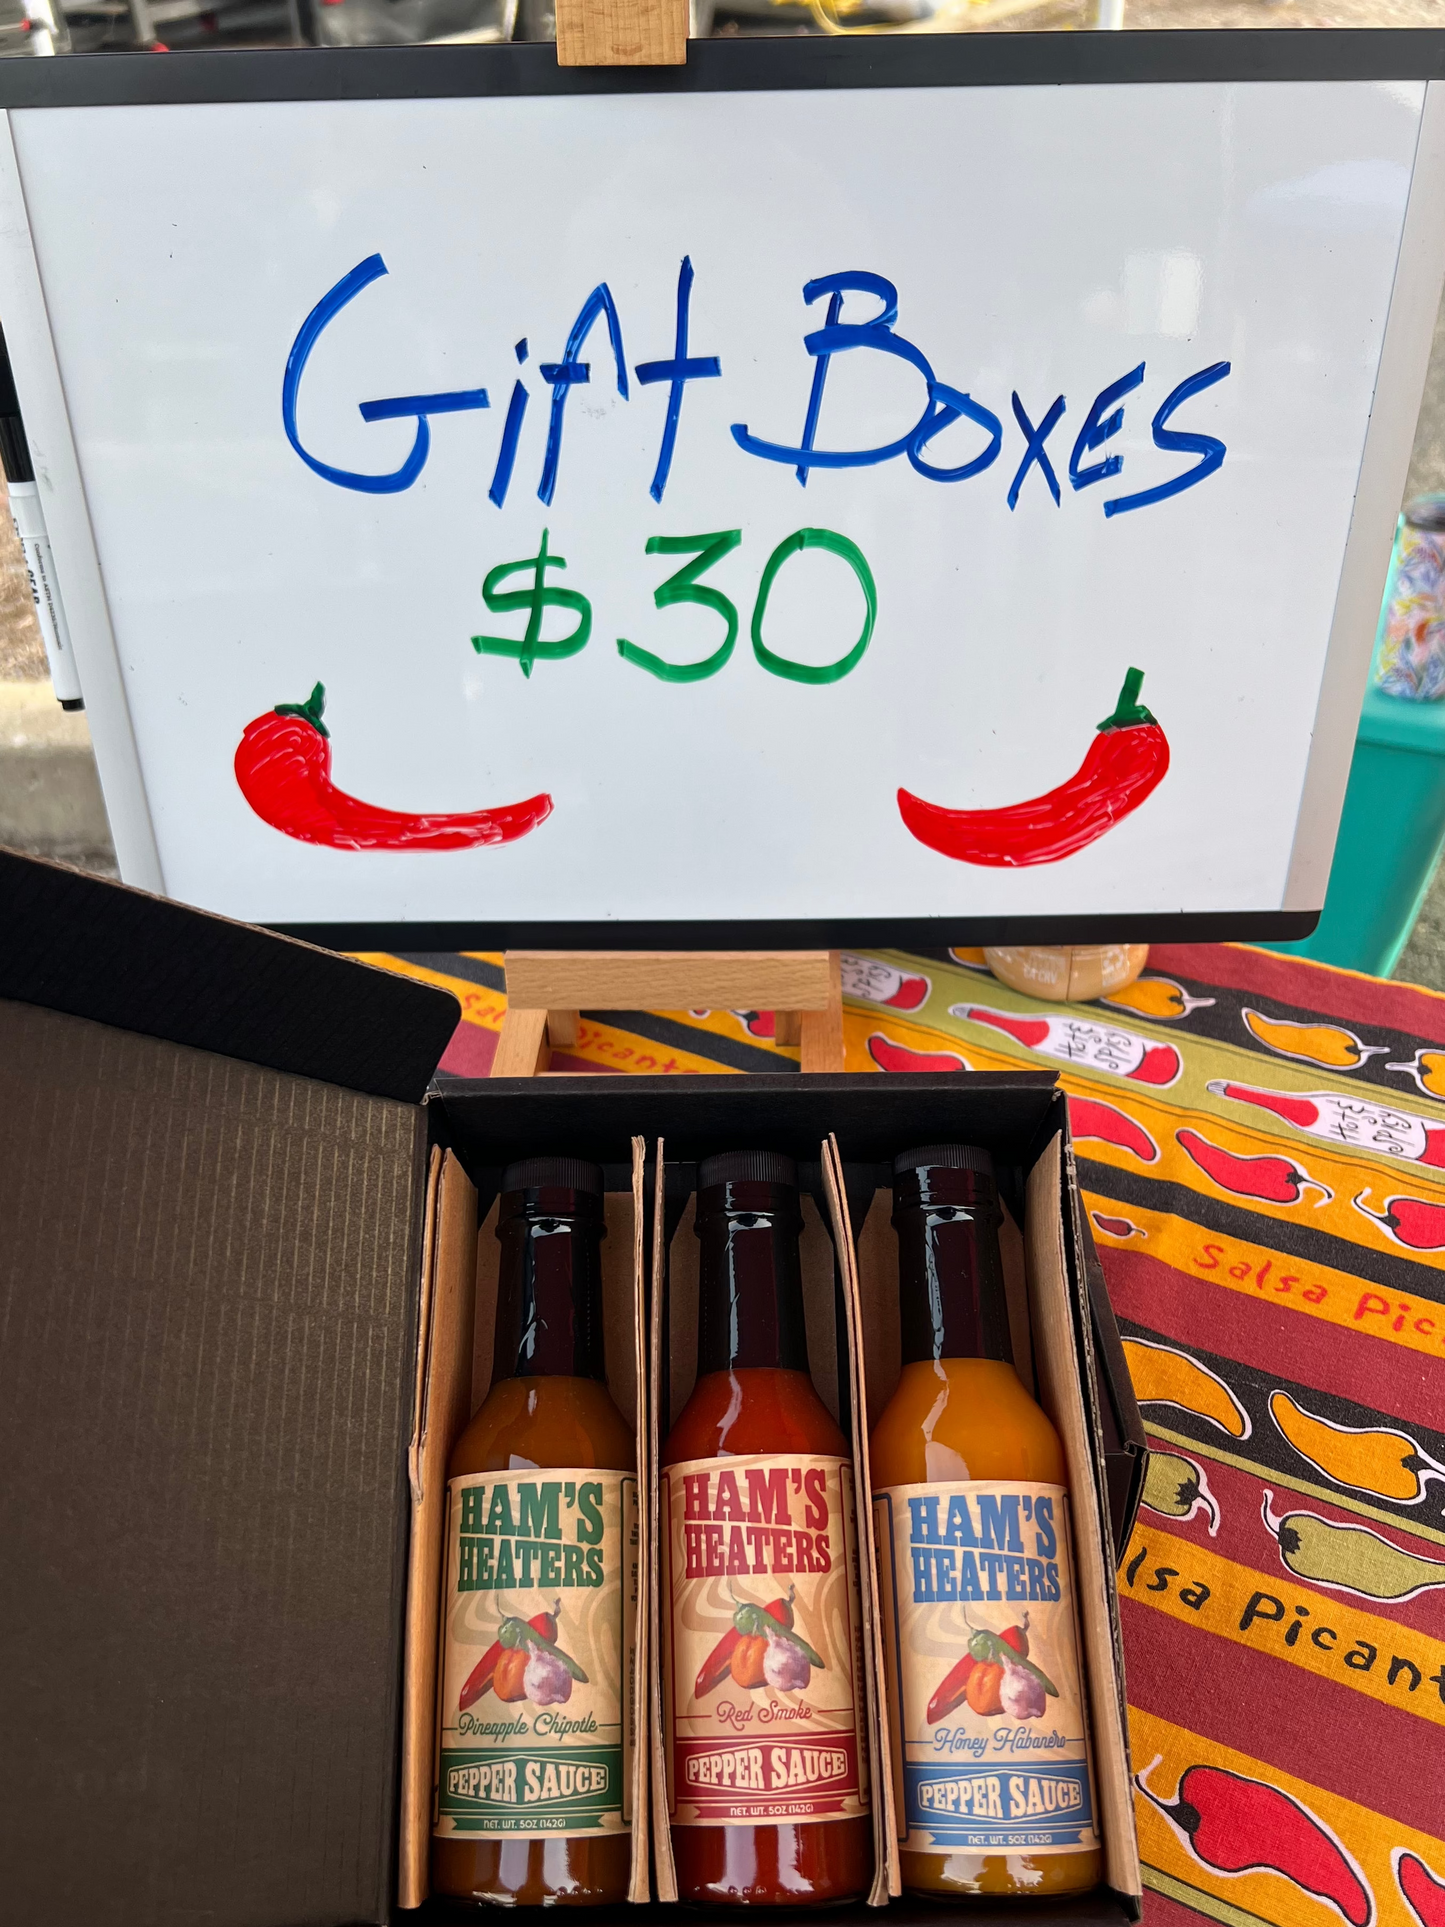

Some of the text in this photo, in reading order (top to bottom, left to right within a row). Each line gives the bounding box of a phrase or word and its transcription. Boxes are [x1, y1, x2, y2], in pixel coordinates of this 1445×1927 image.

[282, 253, 722, 510] Gift
[471, 528, 878, 685] $30
[577, 1025, 700, 1073] icant
[1192, 1243, 1445, 1346] Salsa Pic
[461, 1483, 603, 1545] HAM'S
[682, 1468, 829, 1533] HAM'S
[685, 1523, 832, 1579] HEATERS
[908, 1495, 1057, 1560] HAM'S
[458, 1537, 604, 1592] HEATERS
[911, 1547, 1060, 1603] HEATERS
[458, 1711, 598, 1743] Pineapple Chipotle
[717, 1699, 813, 1732] Red Smoke
[933, 1726, 1066, 1758] Honey Habanero
[450, 1761, 605, 1803] PEPPER SAUCE
[688, 1747, 845, 1789] PEPPER SAUCE
[788, 1804, 814, 1814] (142G)
[920, 1776, 1080, 1818] PEPPER SAUCE
[539, 1818, 566, 1829] (142G)
[1027, 1834, 1052, 1844] (142G)
